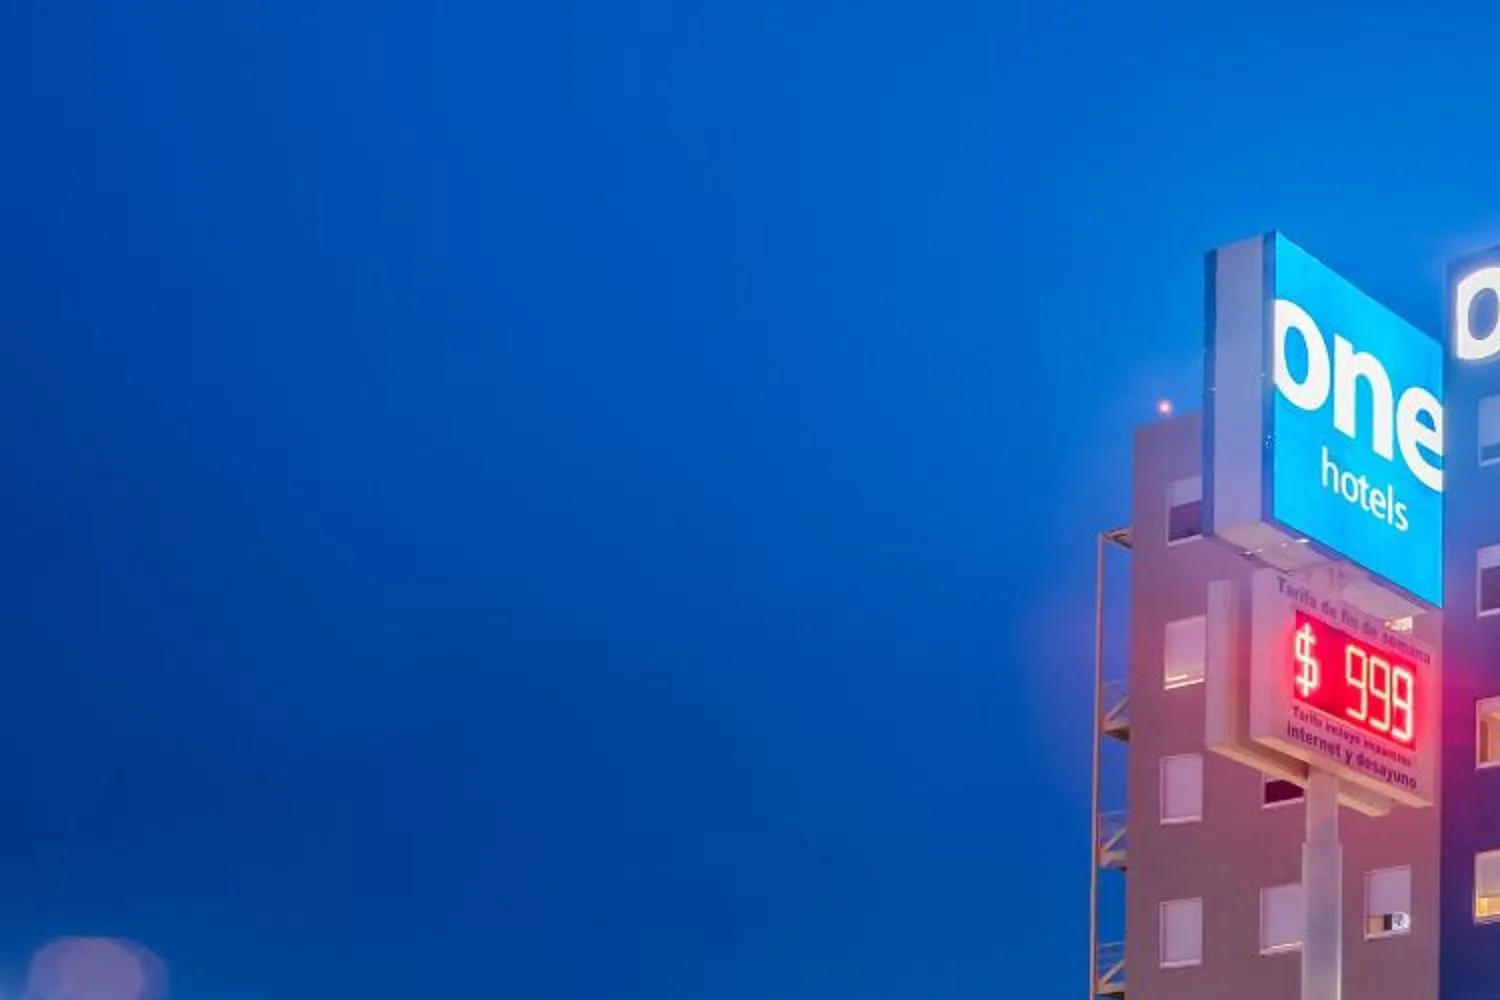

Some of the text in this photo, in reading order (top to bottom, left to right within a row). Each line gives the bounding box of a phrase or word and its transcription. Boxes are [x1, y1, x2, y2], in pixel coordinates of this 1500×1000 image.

[1274, 298, 1444, 492] one
[1321, 447, 1409, 534] hotels
[1295, 622, 1414, 742] $ 999
[1287, 720, 1342, 758] Internet
[1356, 753, 1417, 789] desayuno
